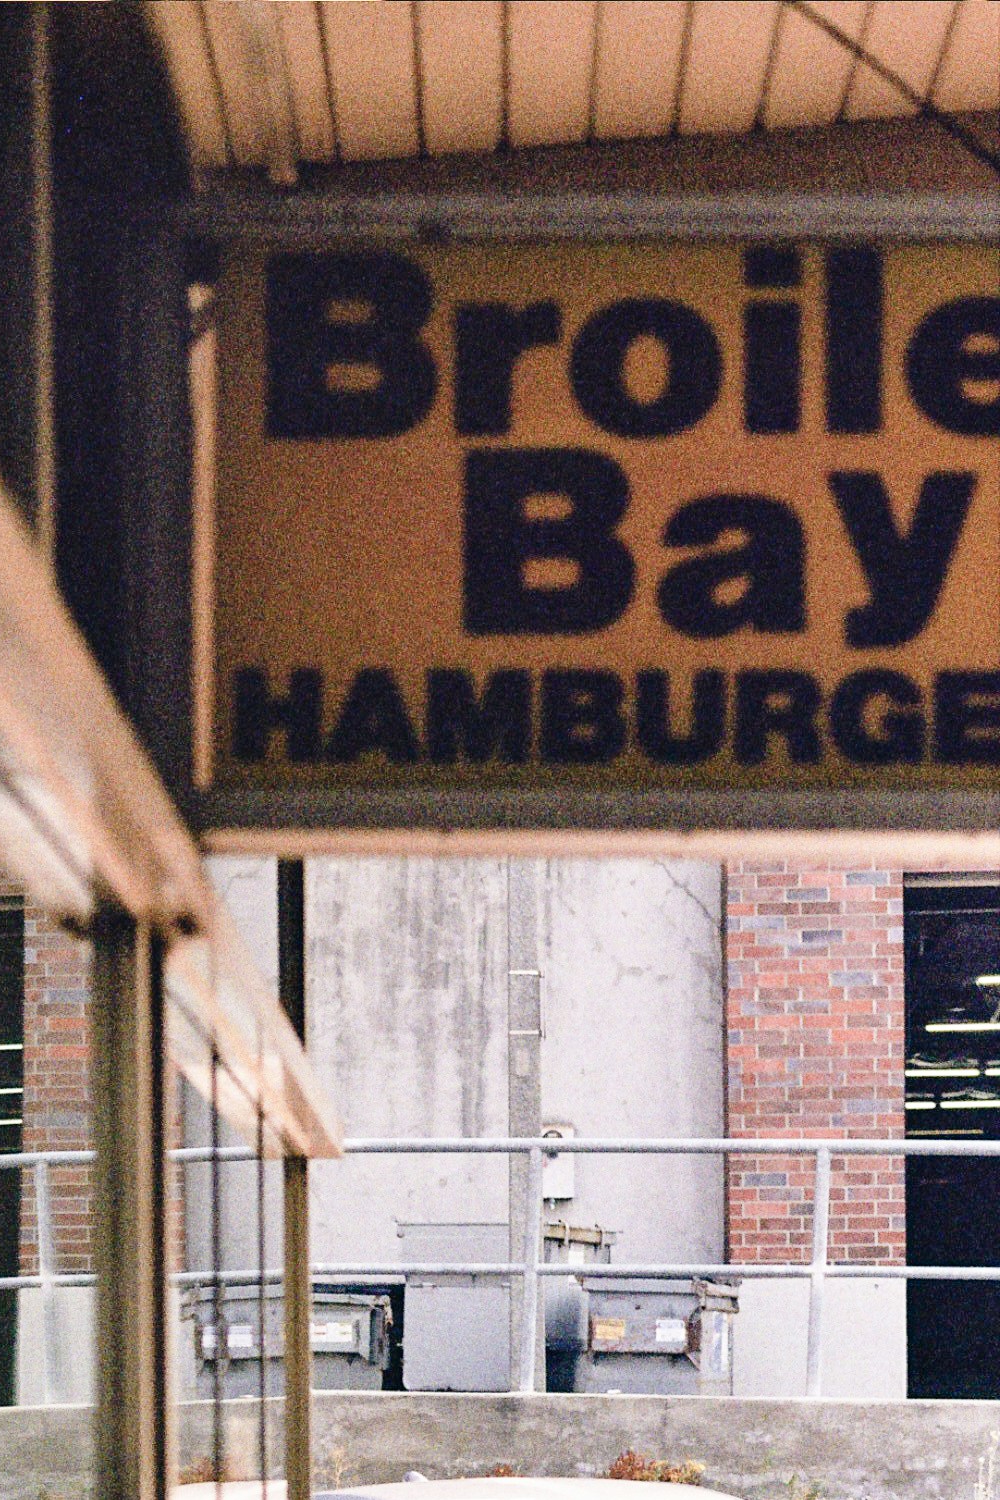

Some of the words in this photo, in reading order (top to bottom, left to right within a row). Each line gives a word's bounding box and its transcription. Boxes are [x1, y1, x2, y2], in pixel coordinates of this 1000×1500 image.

[264, 245, 1000, 439] Broile
[461, 447, 978, 648] Bay
[232, 667, 1000, 766] HAMBURGE
